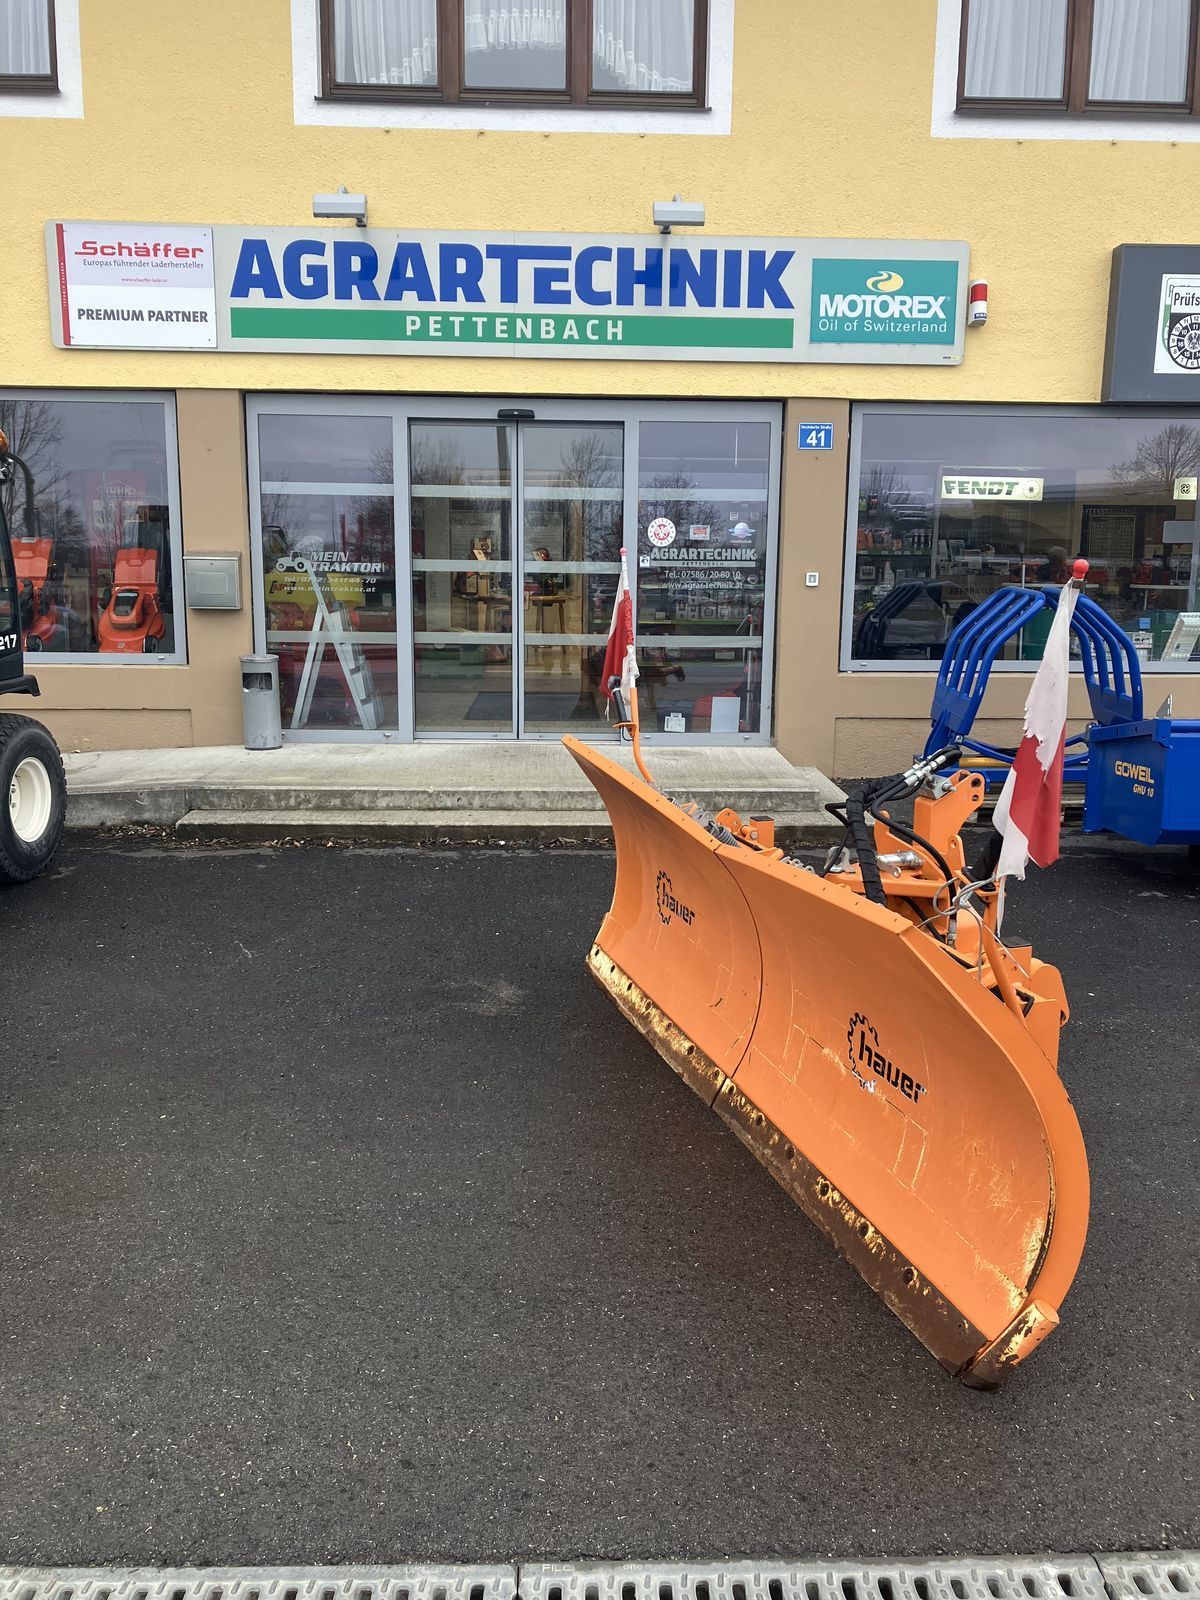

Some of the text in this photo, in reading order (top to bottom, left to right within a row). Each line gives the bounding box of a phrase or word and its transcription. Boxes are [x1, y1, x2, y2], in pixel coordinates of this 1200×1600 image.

[74, 241, 205, 258] Schäffer
[83, 259, 204, 269] Europas führender Laderhersteller
[229, 238, 796, 309] AGRARTECHNIK
[819, 294, 947, 319] MOTOREX
[77, 308, 209, 323] PREMIUM PARTNER
[405, 315, 624, 342] PETTENBACH
[819, 319, 947, 333] Oil of Switzerland
[806, 430, 826, 447] 41
[944, 480, 1019, 495] FENDT
[311, 552, 349, 562] MEIN
[650, 548, 756, 560] AGRARTECHNIK
[661, 883, 696, 926] hauer
[859, 1030, 926, 1104] hauer
